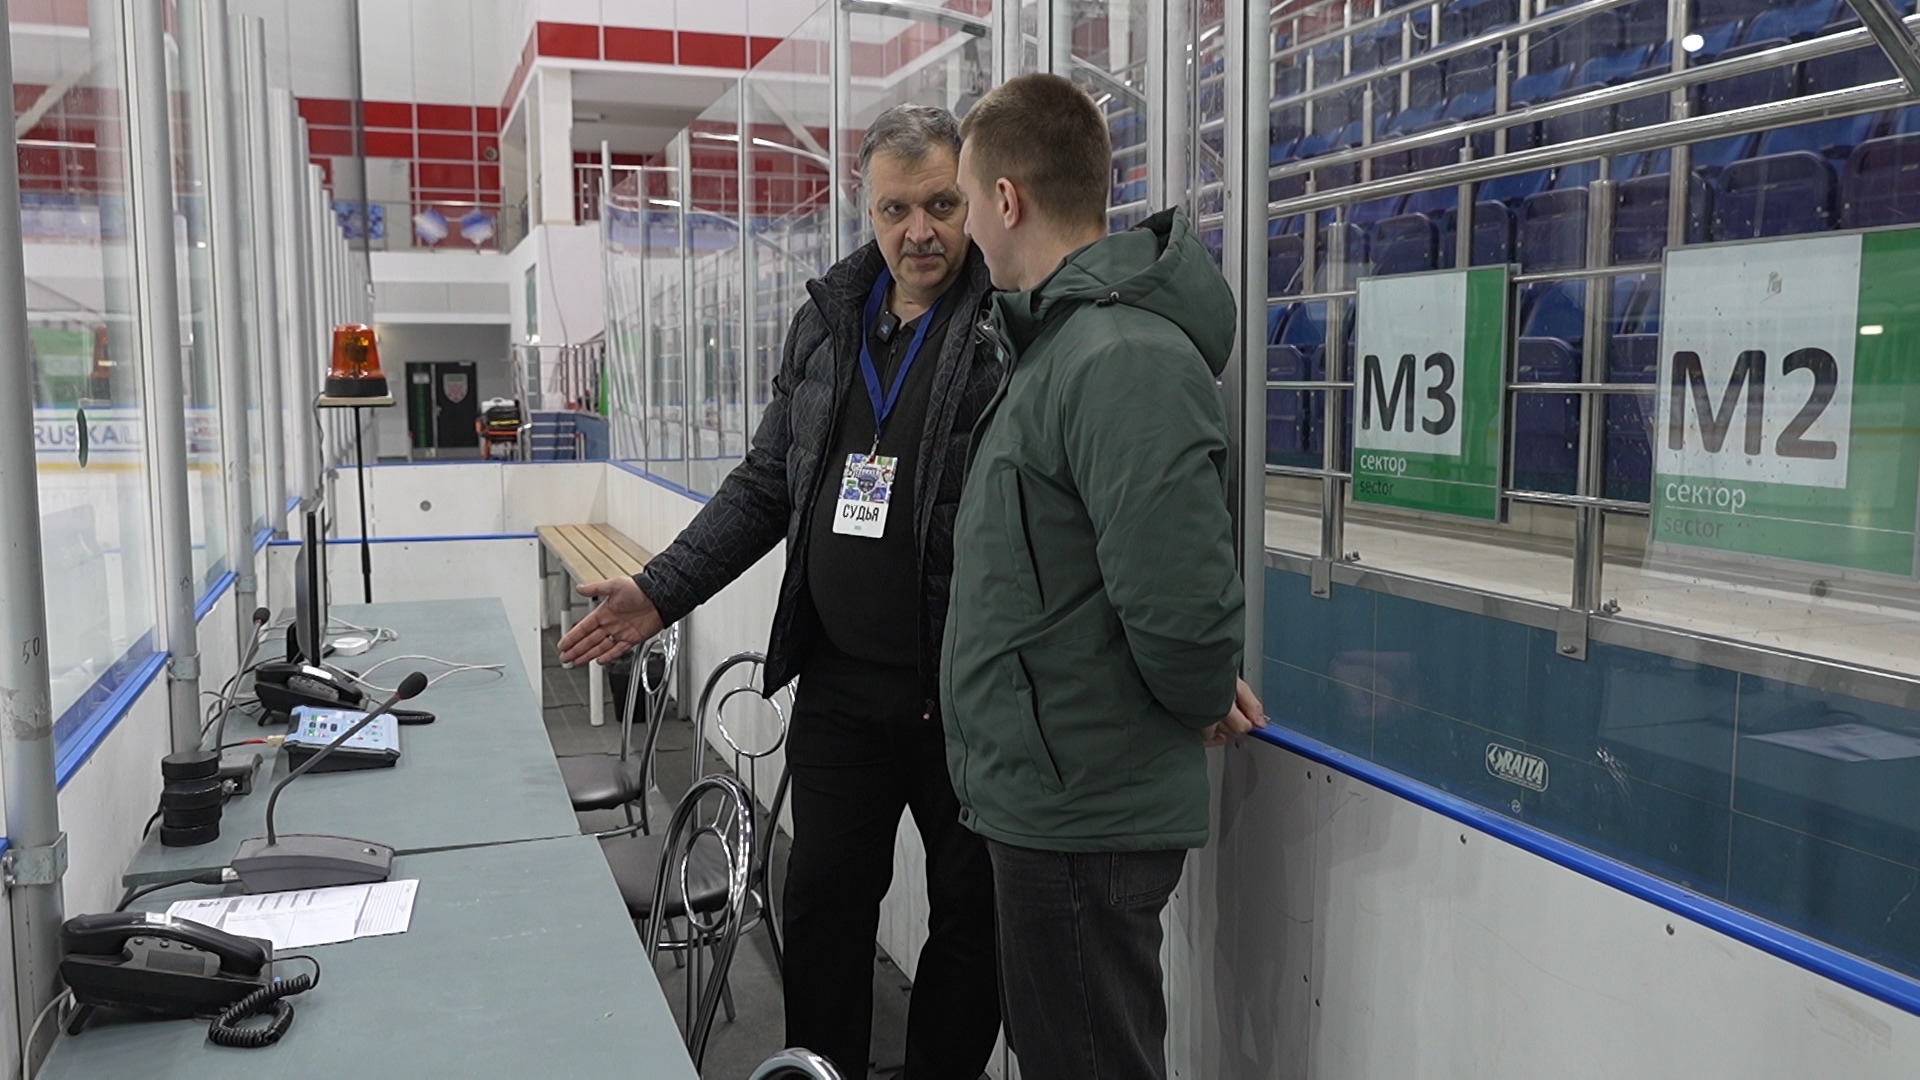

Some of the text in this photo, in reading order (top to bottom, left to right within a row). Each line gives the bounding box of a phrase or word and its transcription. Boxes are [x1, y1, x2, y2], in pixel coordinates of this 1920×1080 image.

[1360, 454, 1407, 477] сектор
[1360, 481, 1394, 496] sector
[1665, 483, 1746, 514] сектор
[842, 503, 880, 522] СУДЬЯ
[1663, 516, 1723, 539] sector
[22, 636, 40, 665] 50
